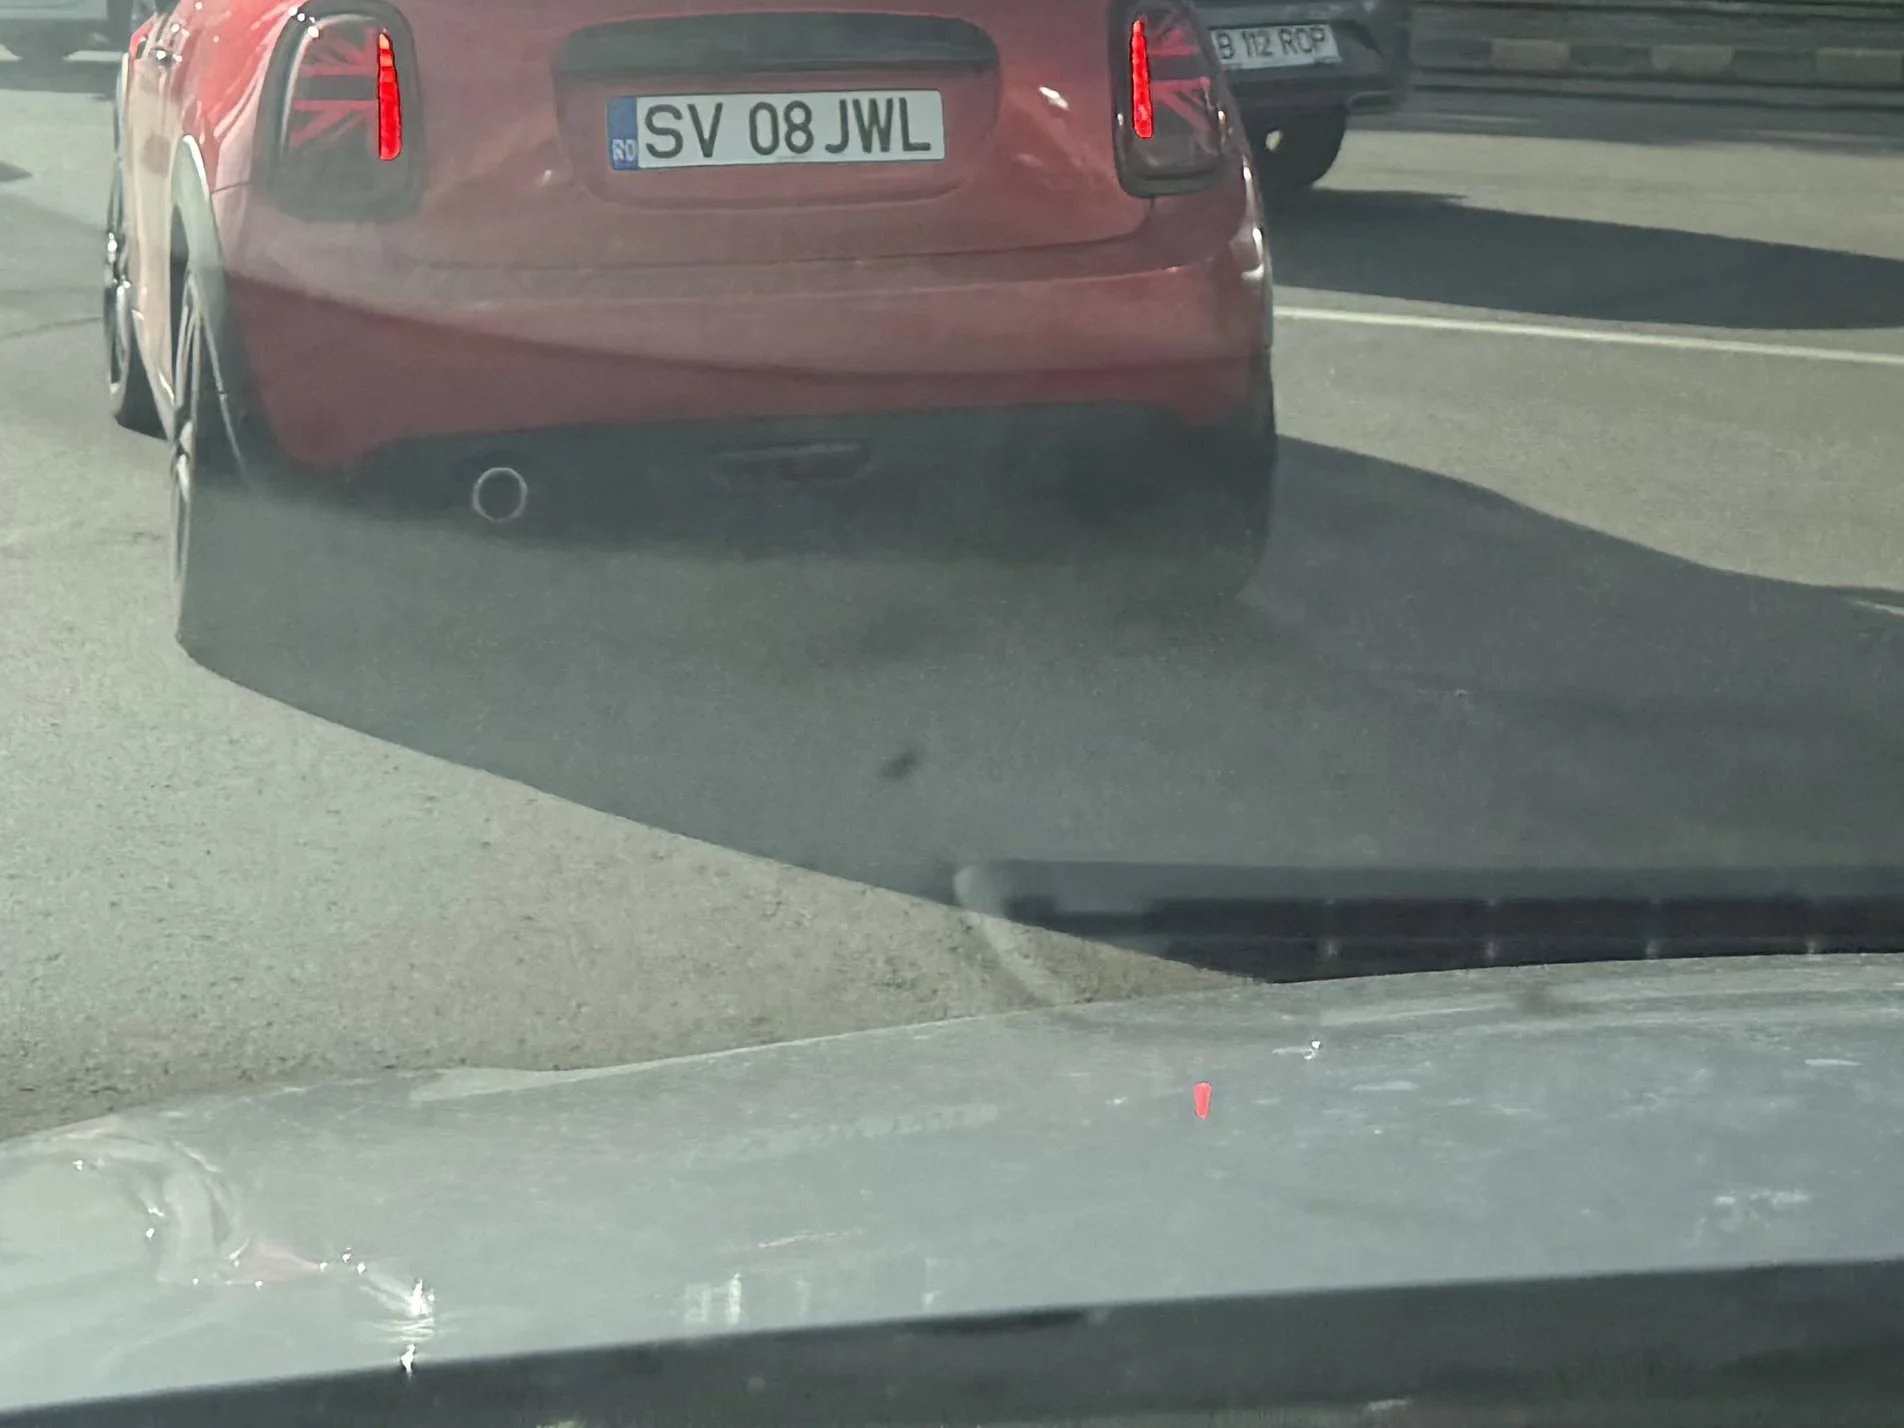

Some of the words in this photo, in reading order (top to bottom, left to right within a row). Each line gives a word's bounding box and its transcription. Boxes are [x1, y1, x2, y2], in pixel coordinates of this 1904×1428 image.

[1216, 31, 1236, 60] B
[644, 102, 724, 159] SV
[749, 100, 815, 156] 08
[824, 97, 932, 154] JWL
[612, 139, 637, 161] RO
